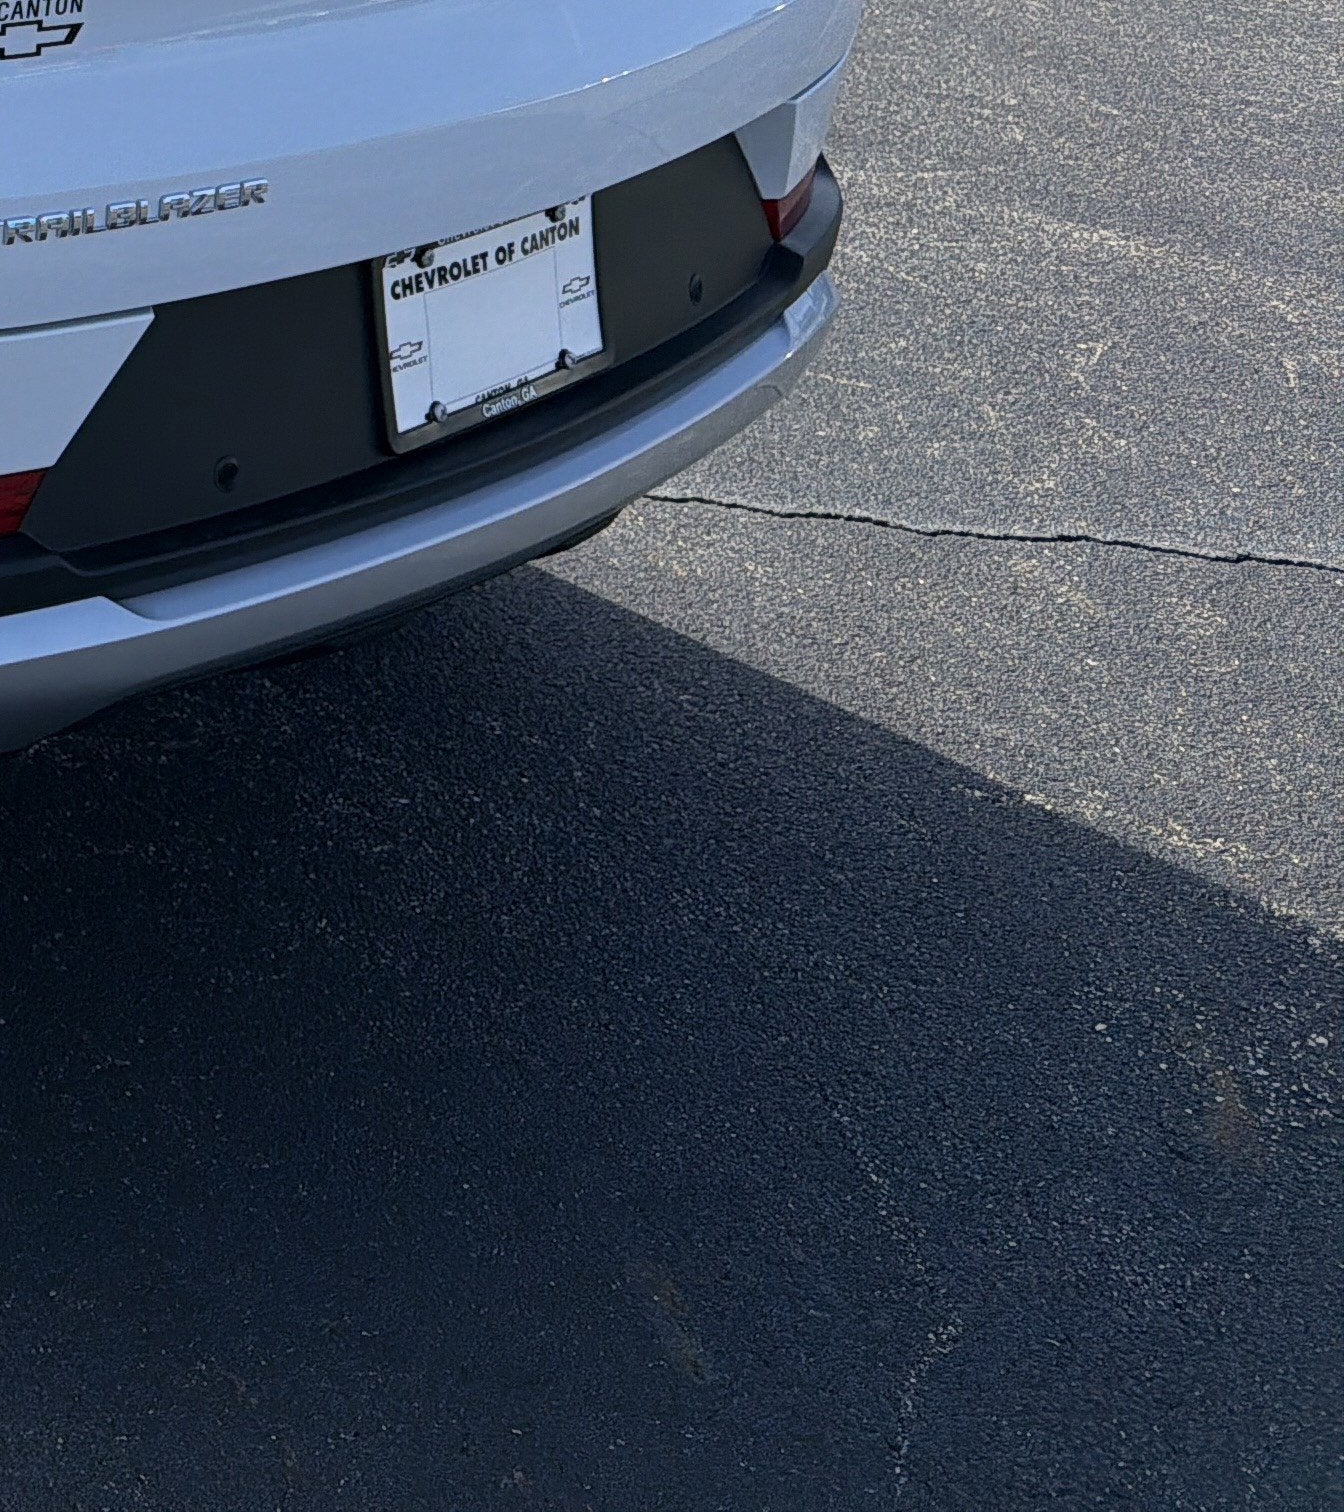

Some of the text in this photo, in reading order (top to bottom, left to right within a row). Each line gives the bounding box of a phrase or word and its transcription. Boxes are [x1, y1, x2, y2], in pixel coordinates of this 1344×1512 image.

[390, 250, 489, 301] CHEVROLET
[494, 241, 515, 266] OF
[520, 216, 580, 256] CANTON
[521, 384, 538, 402] GA
